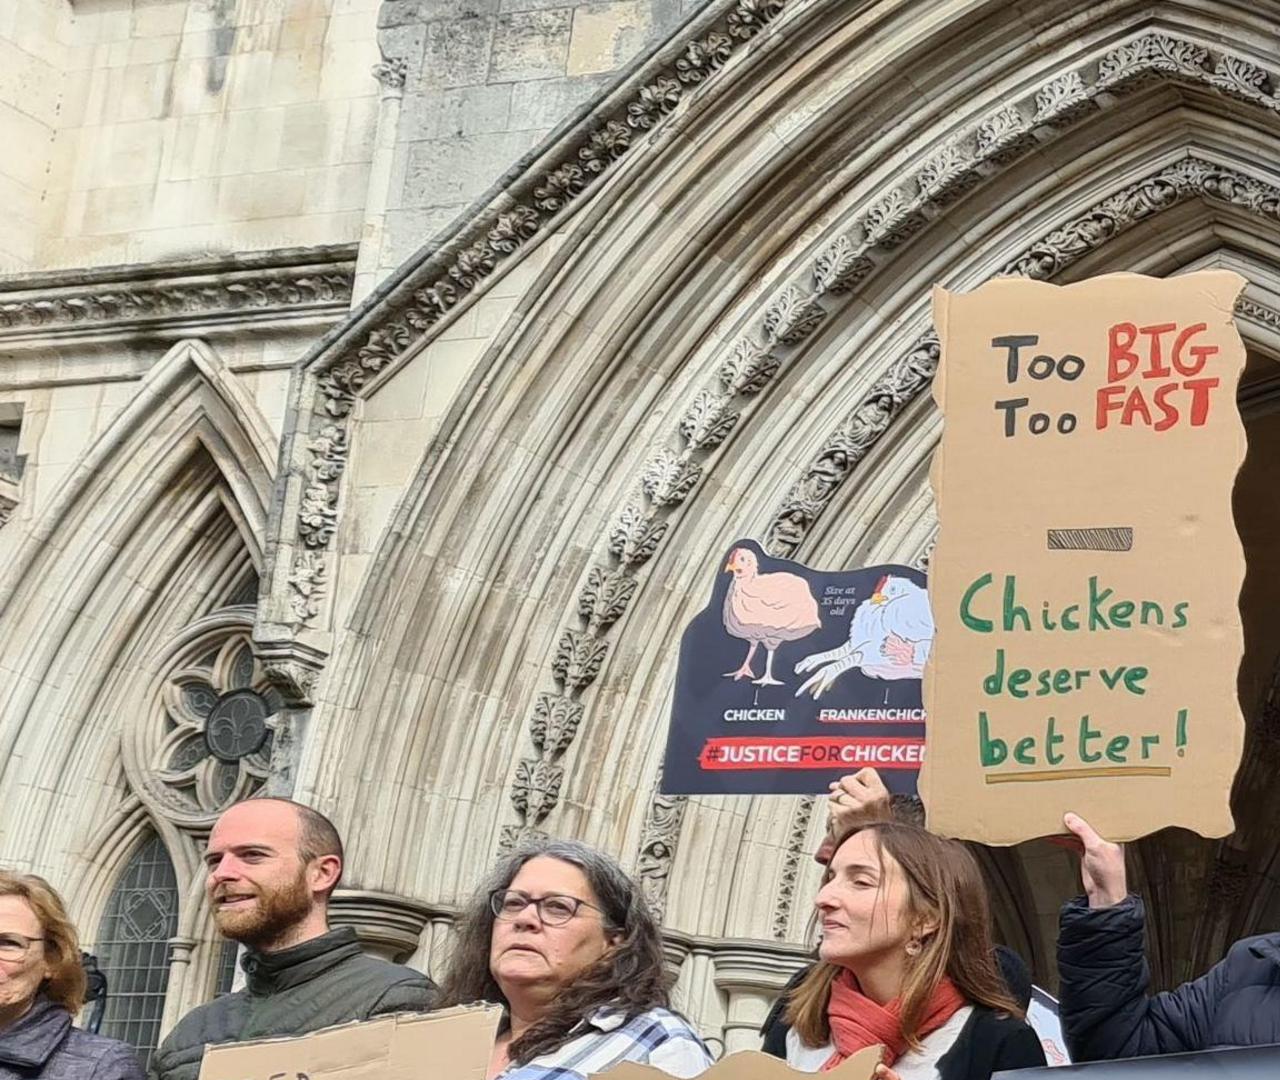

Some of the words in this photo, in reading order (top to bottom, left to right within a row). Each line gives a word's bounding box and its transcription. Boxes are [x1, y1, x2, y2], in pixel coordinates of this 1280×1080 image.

[991, 335, 1085, 383] Too
[1107, 322, 1219, 383] BIG
[994, 397, 1077, 437] Too
[1095, 378, 1220, 432] FAST
[958, 572, 1190, 634] Chickens
[983, 649, 1150, 699] deserve
[723, 708, 786, 721] CHICKEN
[978, 709, 1188, 767] better!
